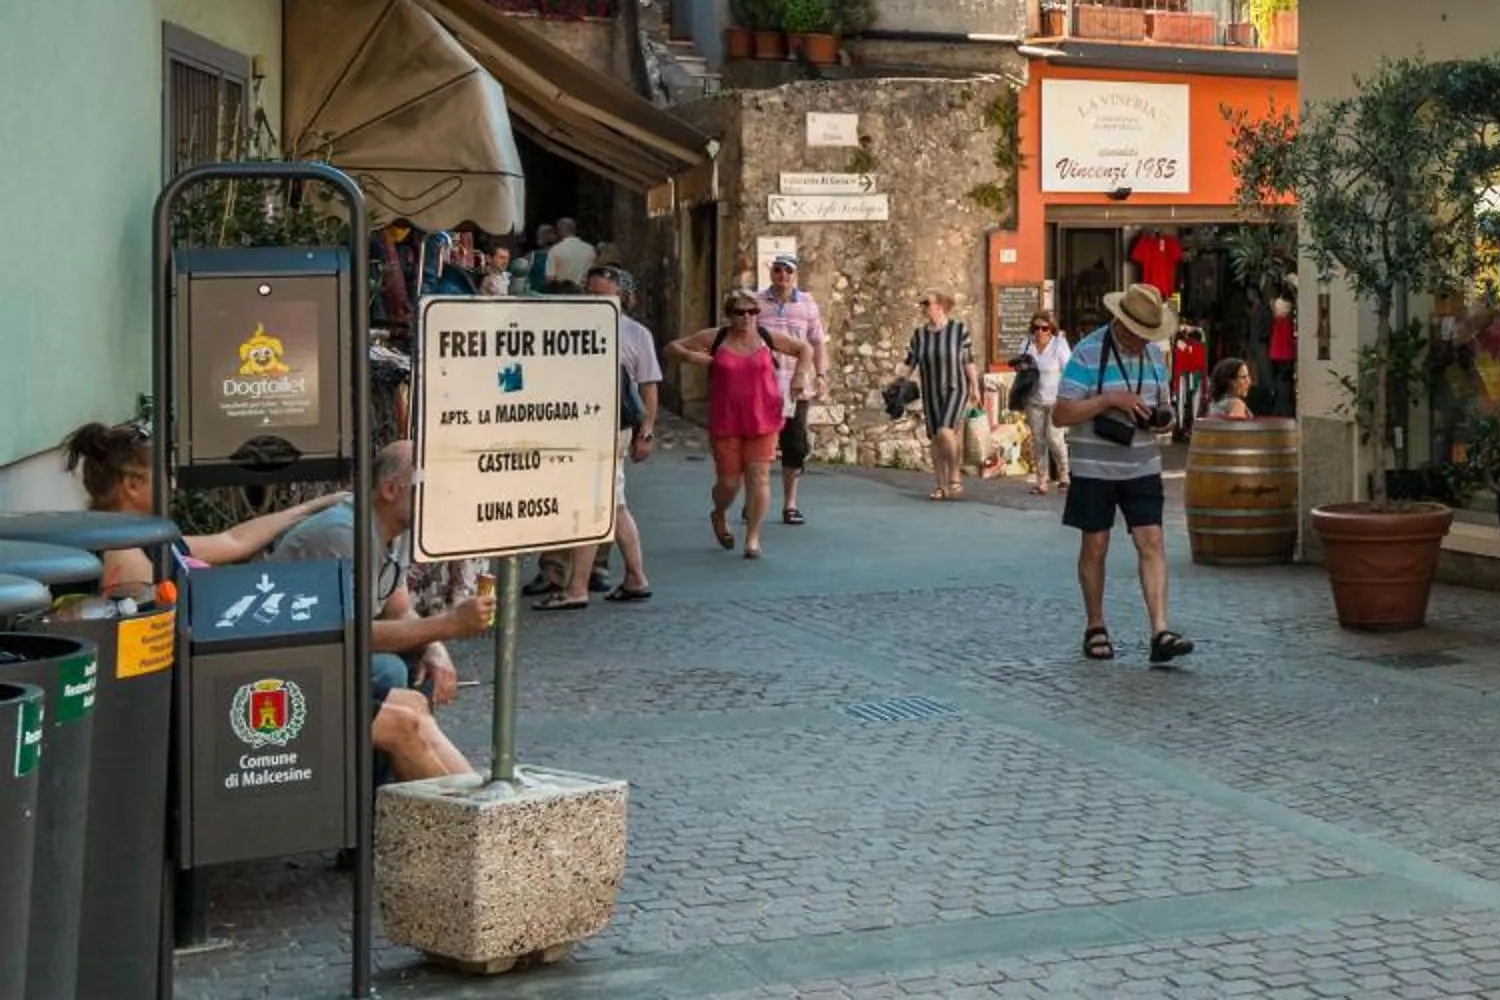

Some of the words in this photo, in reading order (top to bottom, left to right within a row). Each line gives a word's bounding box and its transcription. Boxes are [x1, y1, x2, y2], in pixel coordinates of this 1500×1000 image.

[1056, 157, 1127, 184] Vincenzi
[1135, 157, 1178, 179] 1985
[439, 331, 487, 357] FREI
[495, 322, 535, 356] FÜR
[542, 330, 607, 356] HOTEL:
[223, 376, 305, 398] Dogtoilet
[440, 409, 472, 425] APTS.
[478, 409, 491, 424] LA
[495, 401, 579, 423] MADRUGADA
[478, 451, 541, 473] CASTELLO
[477, 501, 513, 522] LUNA
[517, 497, 559, 518] ROSSA
[239, 753, 297, 769] Comune
[225, 773, 239, 788] di
[241, 768, 313, 787] Malcesine
